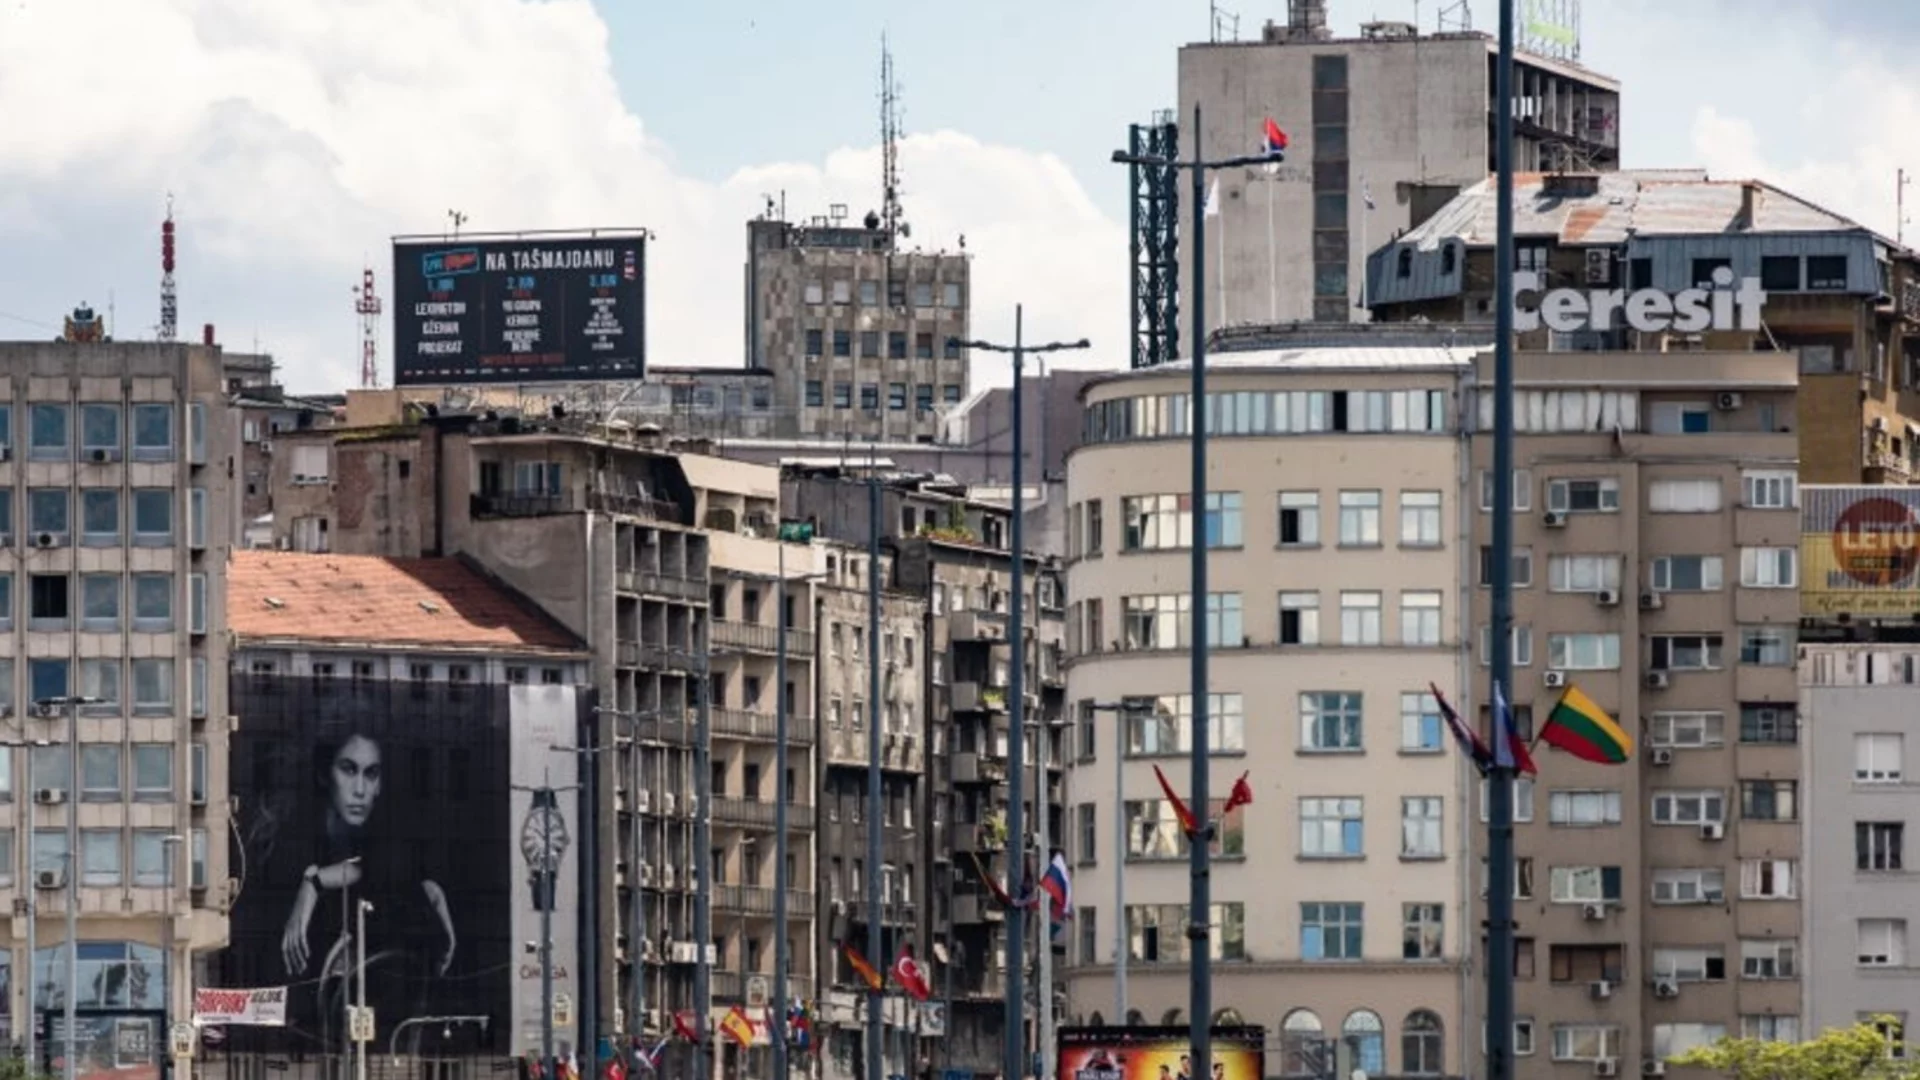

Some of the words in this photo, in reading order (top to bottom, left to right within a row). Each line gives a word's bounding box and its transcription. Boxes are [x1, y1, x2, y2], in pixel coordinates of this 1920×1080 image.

[486, 252, 507, 271] NA
[512, 248, 615, 271] TAŠMAJDANU
[1513, 266, 1767, 332] Ceresit
[1841, 520, 1915, 551] LETO
